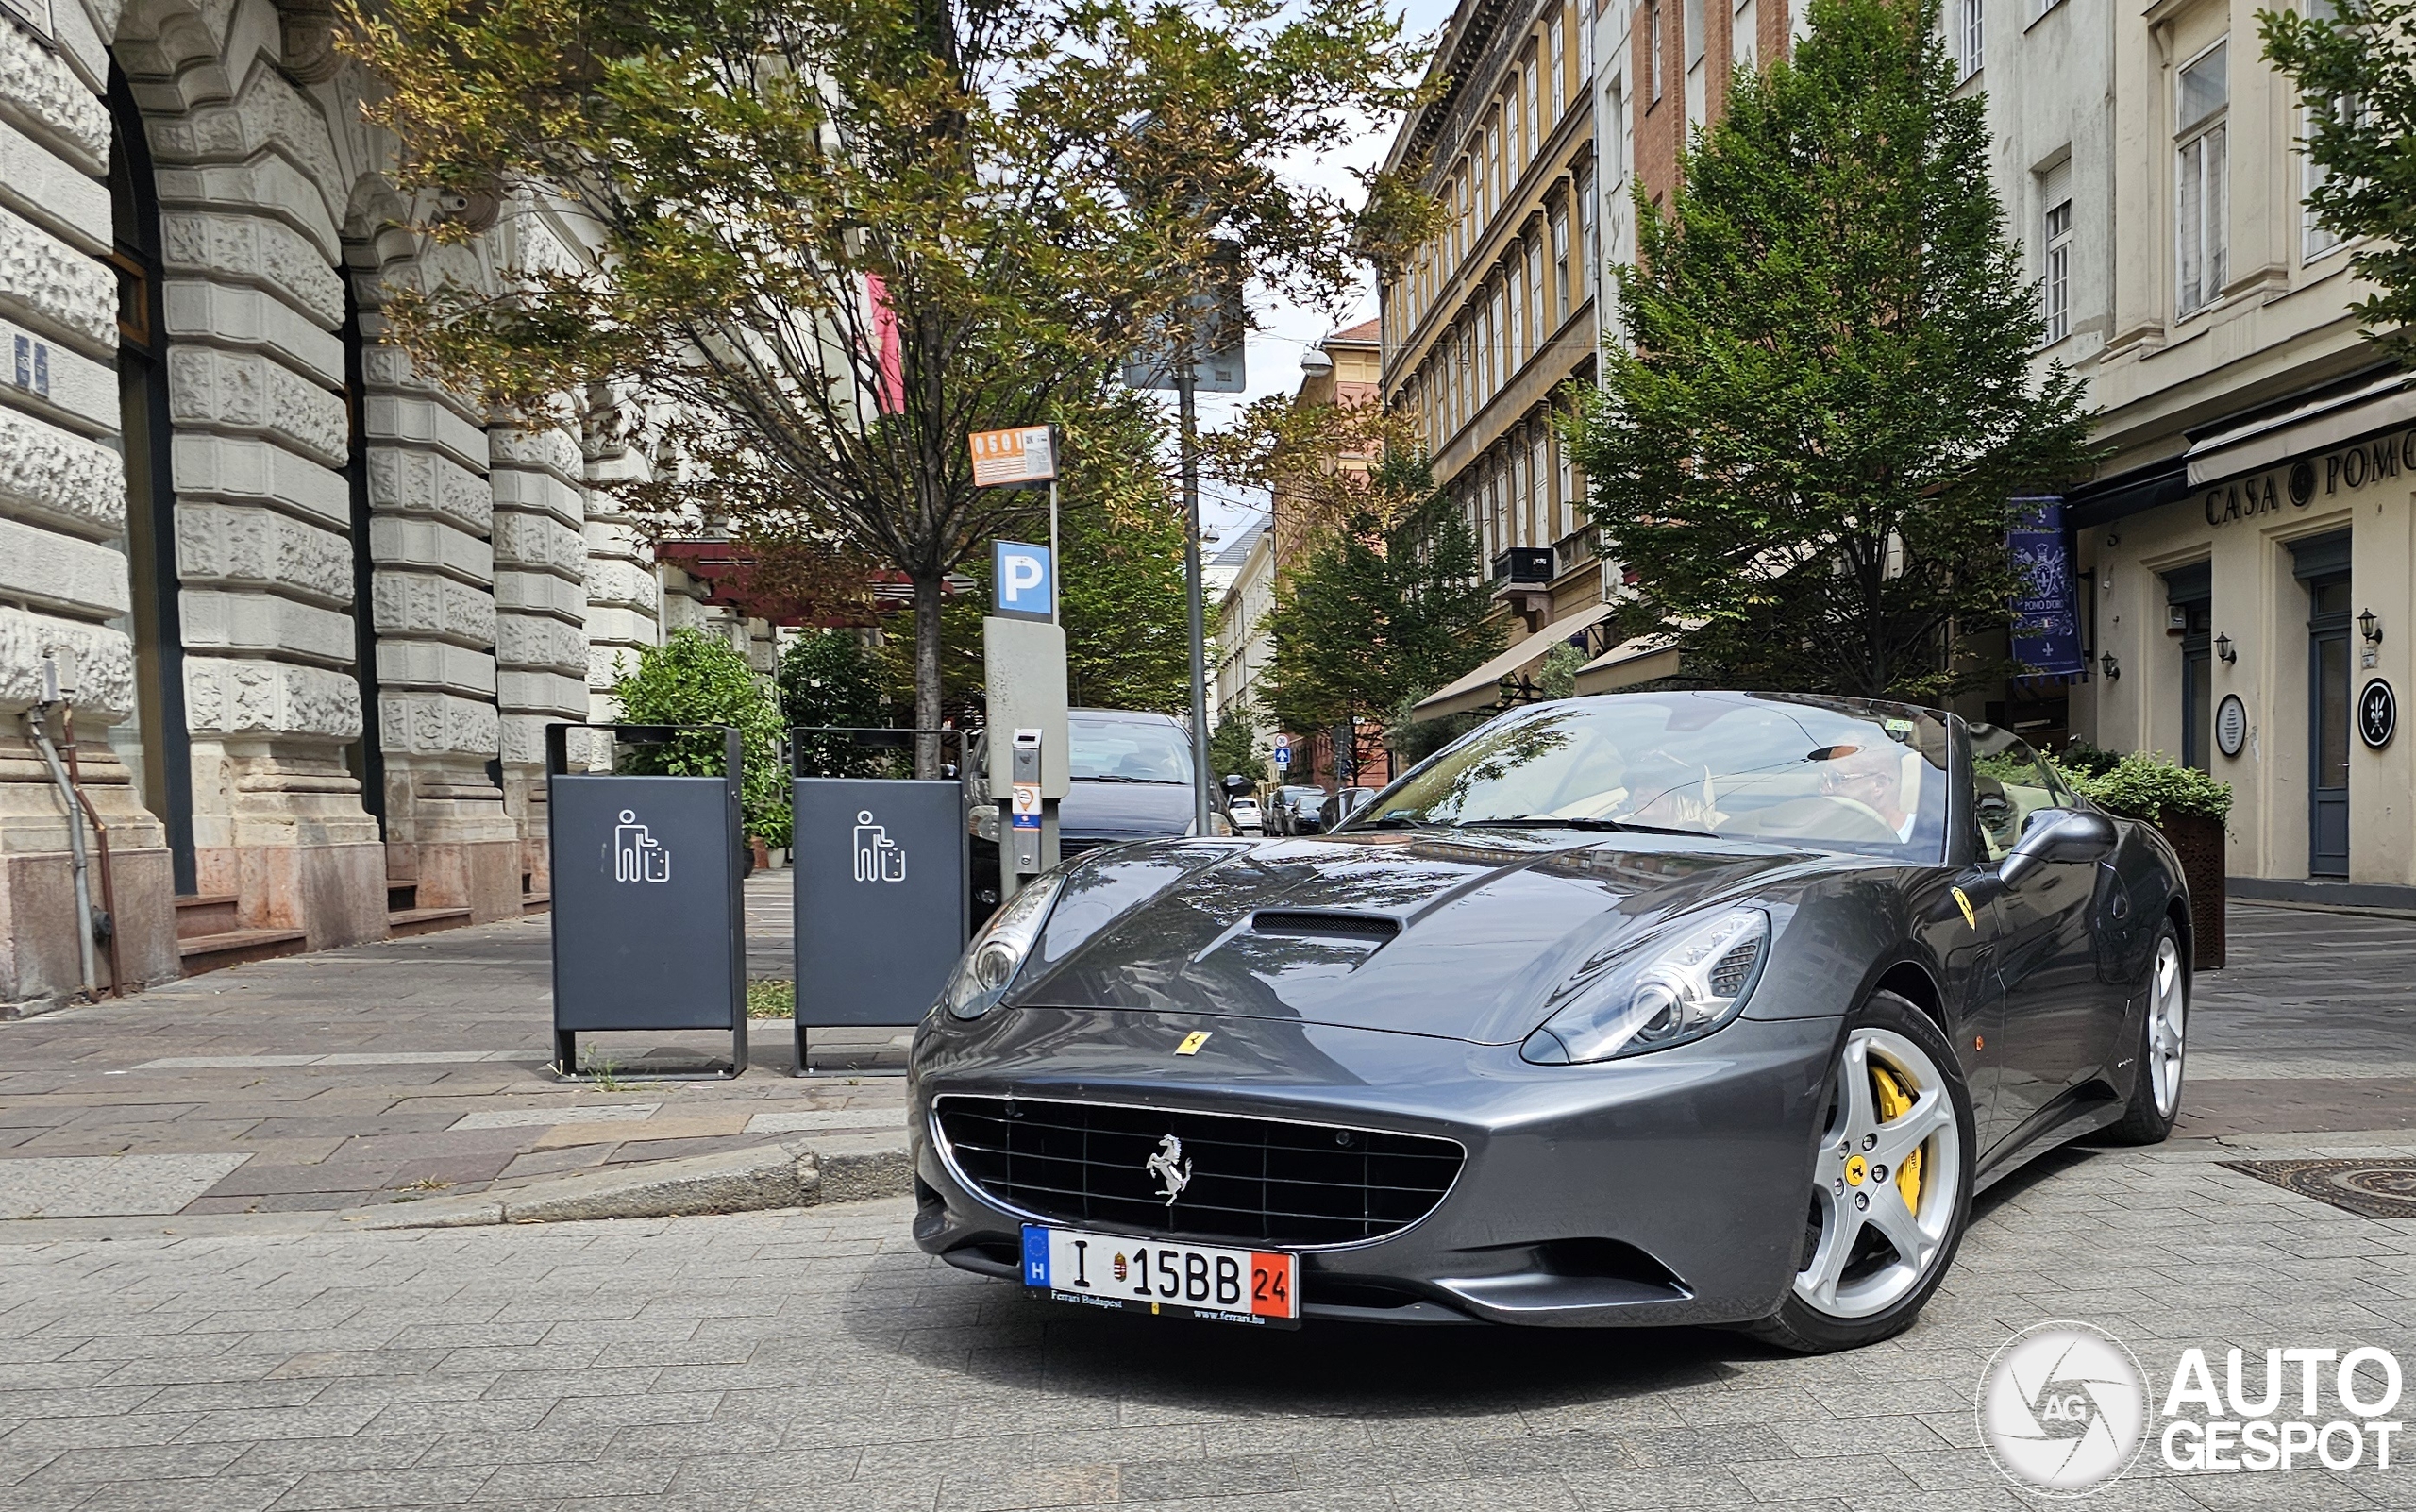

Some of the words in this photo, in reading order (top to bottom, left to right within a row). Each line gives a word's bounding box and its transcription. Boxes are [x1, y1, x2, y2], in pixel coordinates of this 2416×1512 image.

[974, 431, 1023, 455] 0501
[2206, 475, 2278, 526] CASA
[1004, 555, 1044, 602] P
[2024, 599, 2045, 611] POMO
[1031, 1261, 1045, 1281] H
[1073, 1239, 1091, 1288] I
[1132, 1247, 1241, 1305] 15BB
[1252, 1268, 1286, 1302] 24
[1050, 1288, 1081, 1303] Ferrari
[1082, 1293, 1123, 1309] Budapest
[1193, 1309, 1266, 1325] www.ferrari.hu
